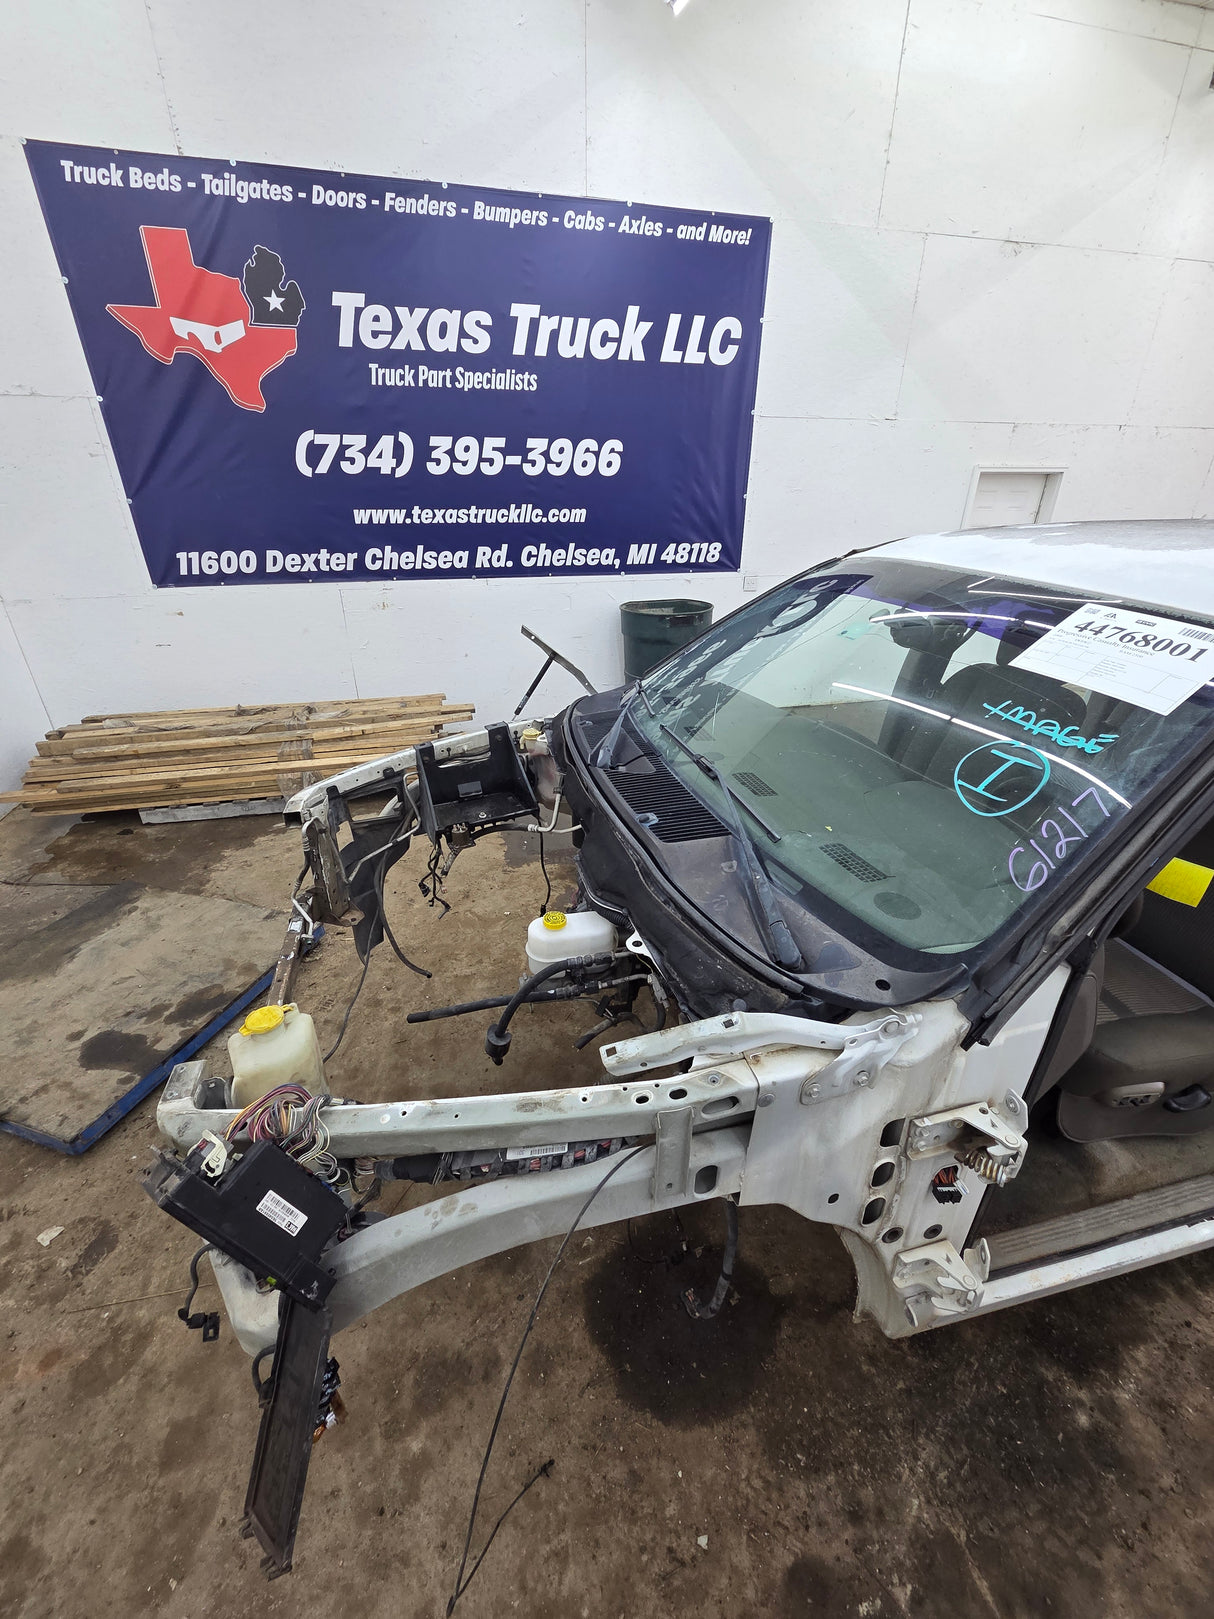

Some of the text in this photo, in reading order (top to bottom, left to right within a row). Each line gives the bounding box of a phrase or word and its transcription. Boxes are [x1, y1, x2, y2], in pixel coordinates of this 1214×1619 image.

[59, 159, 125, 188] Truck
[128, 166, 183, 193] Beds
[200, 171, 294, 204] Tailgates
[311, 184, 367, 210] Doors
[384, 191, 457, 218] Fenders
[472, 200, 549, 229] Bumpers
[563, 209, 606, 232] Cabs
[617, 214, 664, 237] Axles
[676, 221, 708, 242] and
[707, 224, 753, 246] More!
[331, 291, 743, 366] Texas Truck LLC
[368, 362, 538, 392] Truck Part Specialists
[295, 429, 624, 478] (734) 395-3966
[352, 503, 587, 525] www.texastruckllc.com
[175, 541, 723, 576] 11600 Dexter Chelsea Rd. Chelsea, MI 48118
[1074, 620, 1209, 663] 44768001
[1008, 786, 1111, 892] 61217
